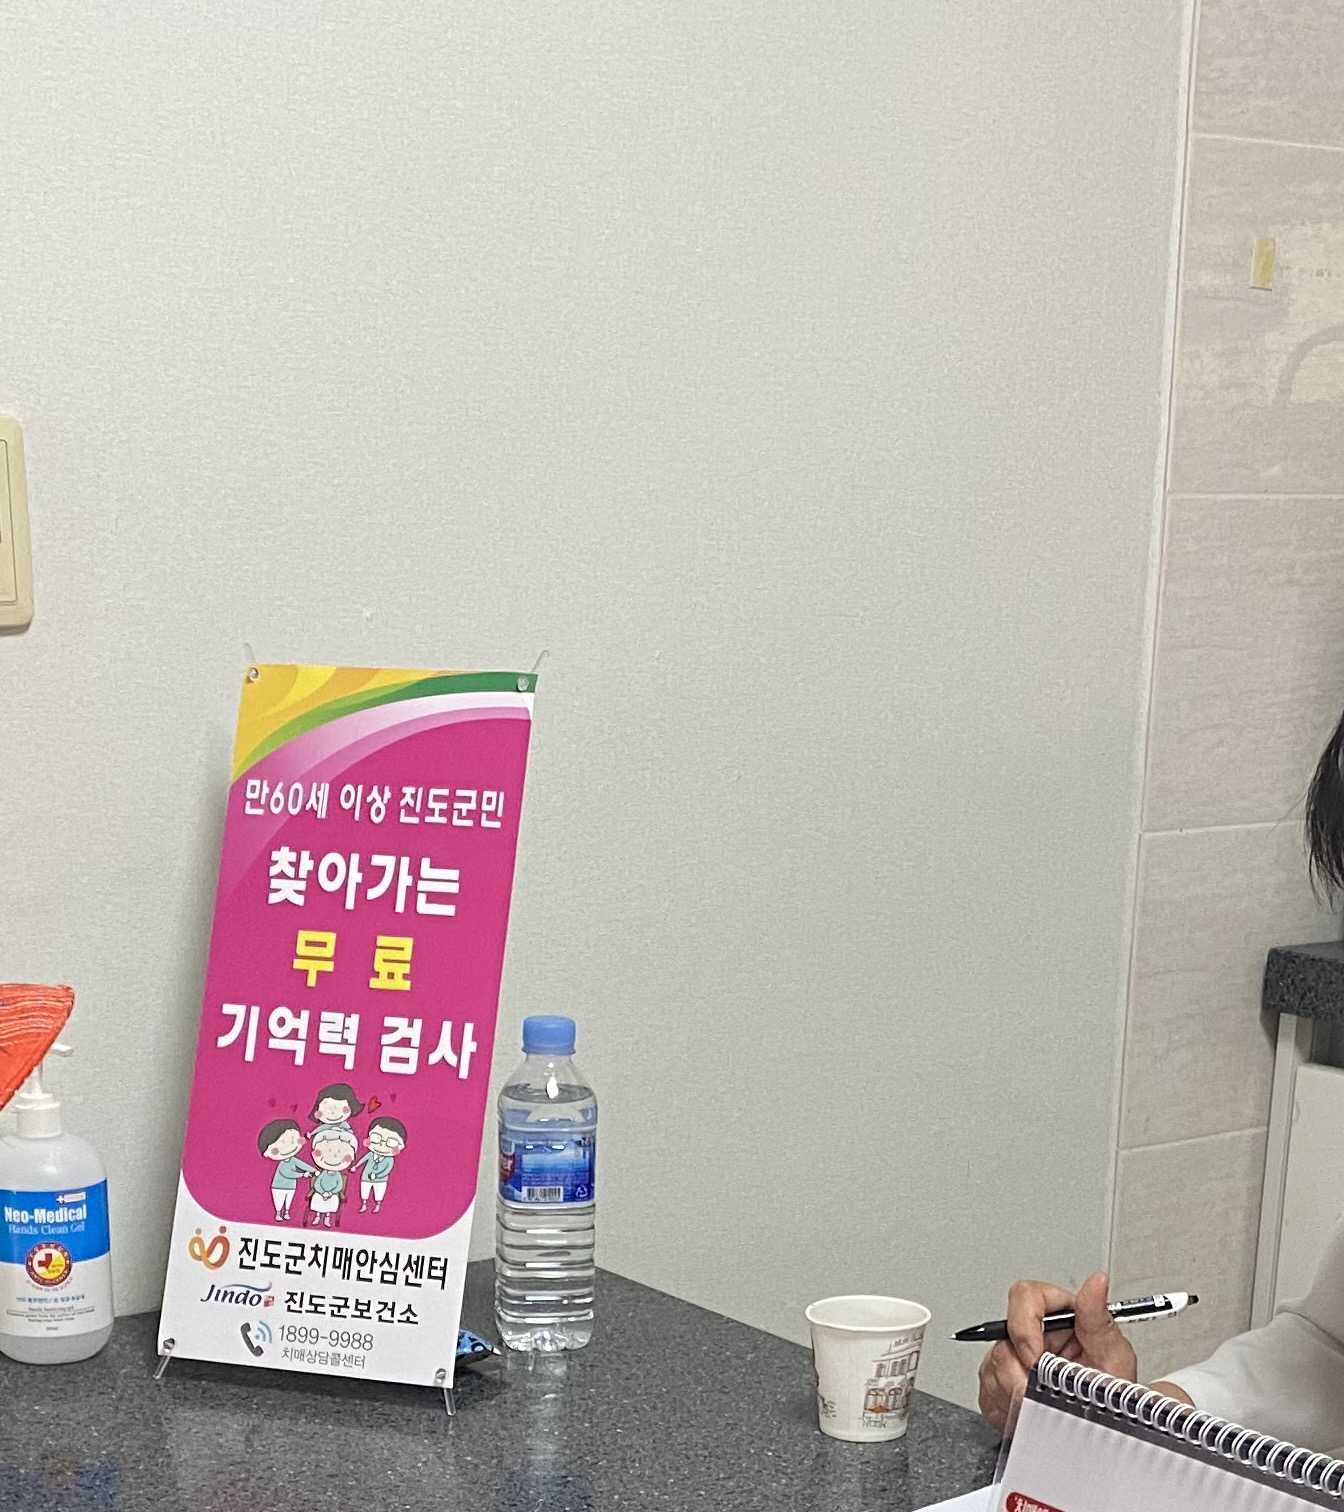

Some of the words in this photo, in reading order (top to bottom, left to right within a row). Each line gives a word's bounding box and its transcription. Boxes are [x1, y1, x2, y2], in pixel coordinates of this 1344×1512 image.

[244, 778, 330, 820] 만60세
[340, 782, 391, 825] 이상
[399, 786, 505, 829] 진도군민
[267, 845, 460, 917] 찾아가는
[216, 1003, 360, 1070] 기억력
[379, 1015, 478, 1080] 검사
[4, 1204, 87, 1224] Neo-Medical
[41, 1224, 69, 1235] Clean
[237, 1236, 449, 1291] 진도군치매안심센터
[200, 1284, 263, 1307] Jindo
[283, 1290, 420, 1325] 진도군보건소
[278, 1324, 375, 1351] 1899-9988
[280, 1346, 367, 1370] 치매상담콜센터
